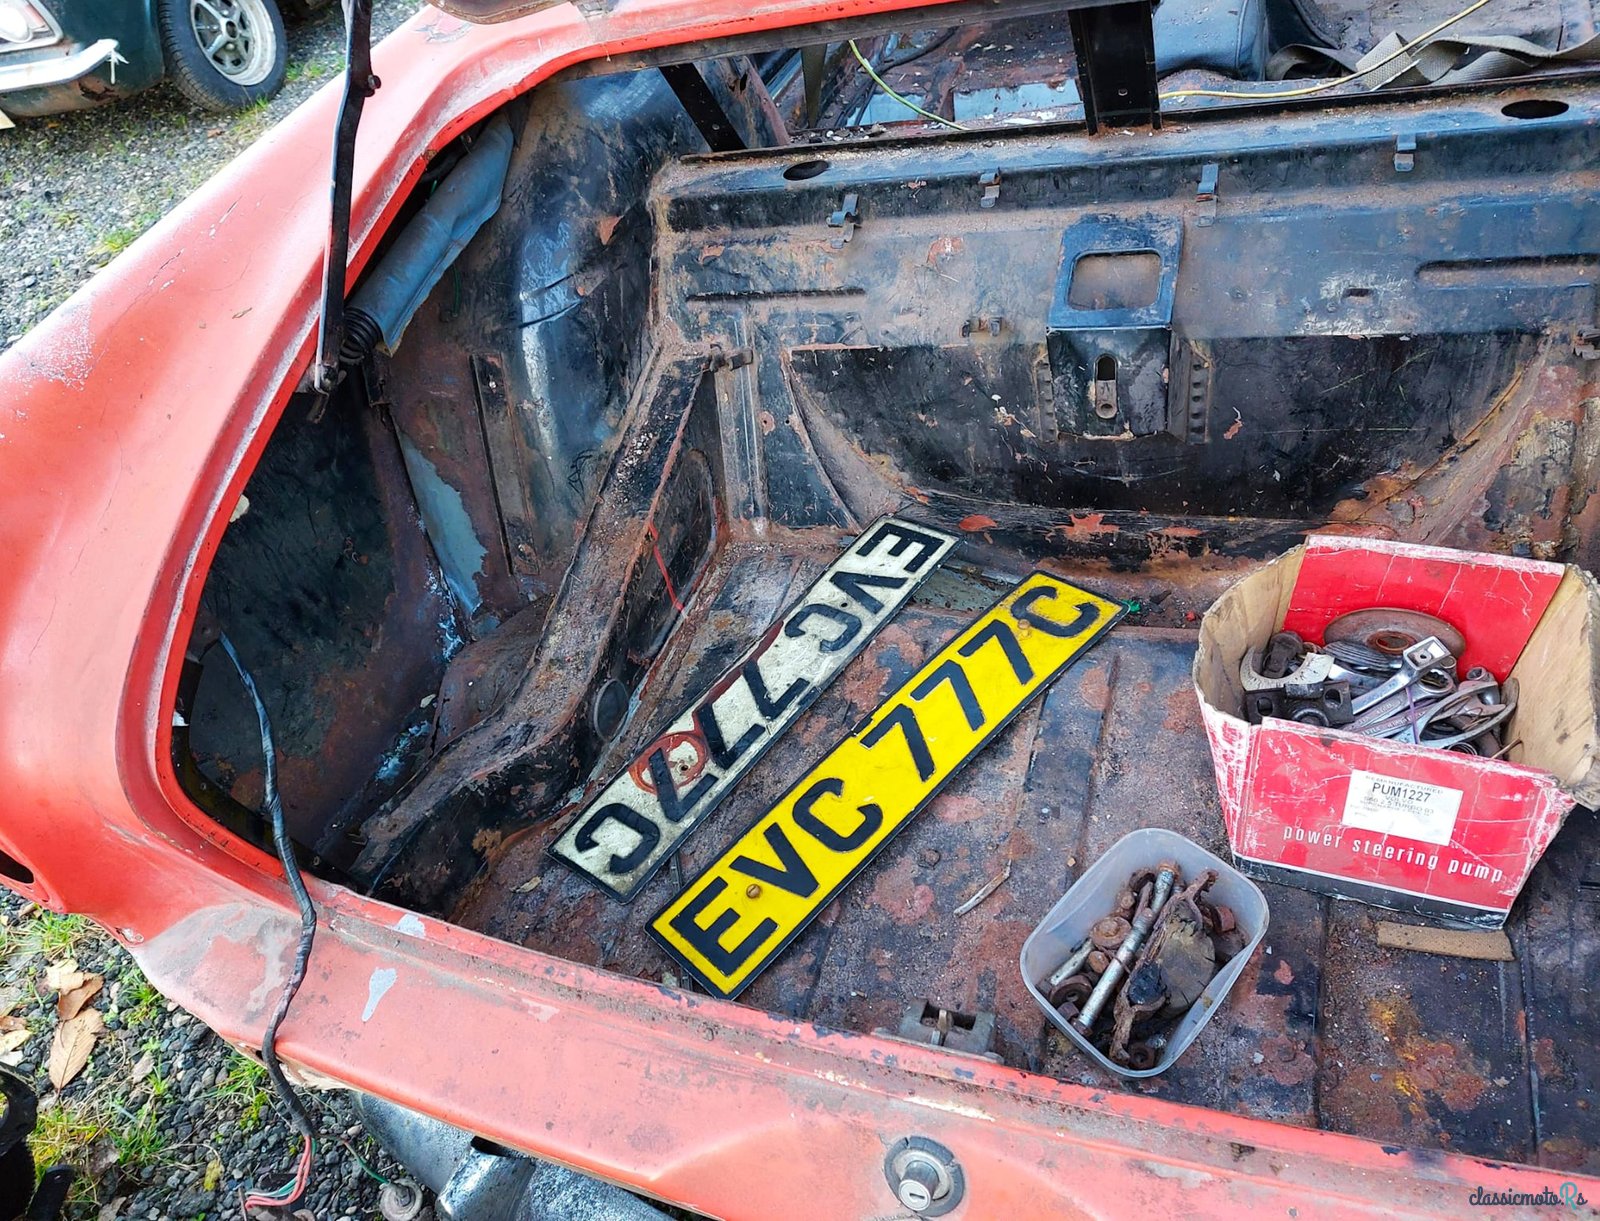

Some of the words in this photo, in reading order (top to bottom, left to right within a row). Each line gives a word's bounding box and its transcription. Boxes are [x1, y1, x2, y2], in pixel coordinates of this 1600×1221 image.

[785, 522, 943, 655] EVC
[575, 656, 810, 876] 777C
[669, 777, 885, 977] EVC
[859, 585, 1101, 783] 777C
[1372, 782, 1431, 803] PUM1227
[1283, 826, 1342, 849] power
[1352, 839, 1439, 870] steering
[1447, 859, 1503, 883] pump
